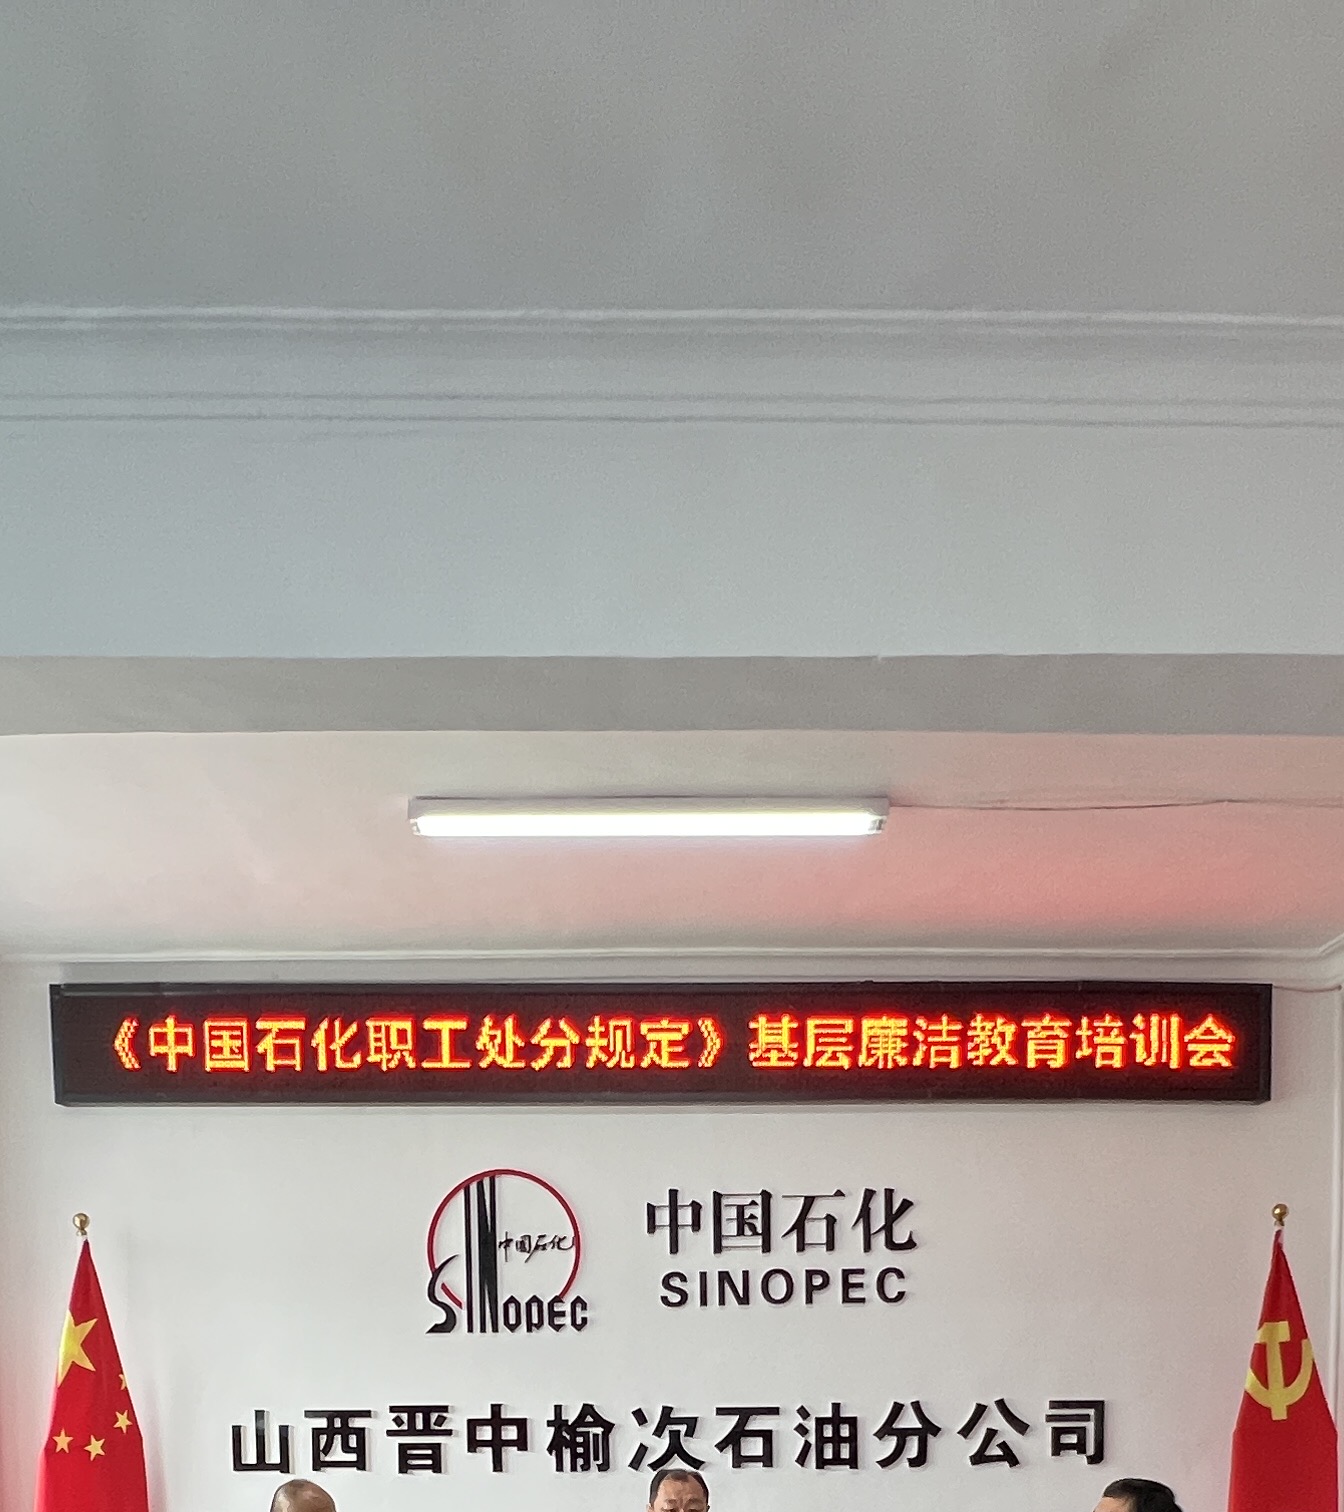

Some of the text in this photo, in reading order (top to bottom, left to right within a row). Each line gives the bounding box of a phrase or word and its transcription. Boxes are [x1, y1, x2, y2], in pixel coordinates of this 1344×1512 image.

[113, 1013, 1237, 1073] 《中国石化职工处分规定》基层廉洁教育培训会
[646, 1187, 917, 1255] 中国石化
[660, 1267, 906, 1308] SINOPEC
[231, 1399, 1109, 1476] 山西晋中榆次石油分公司
